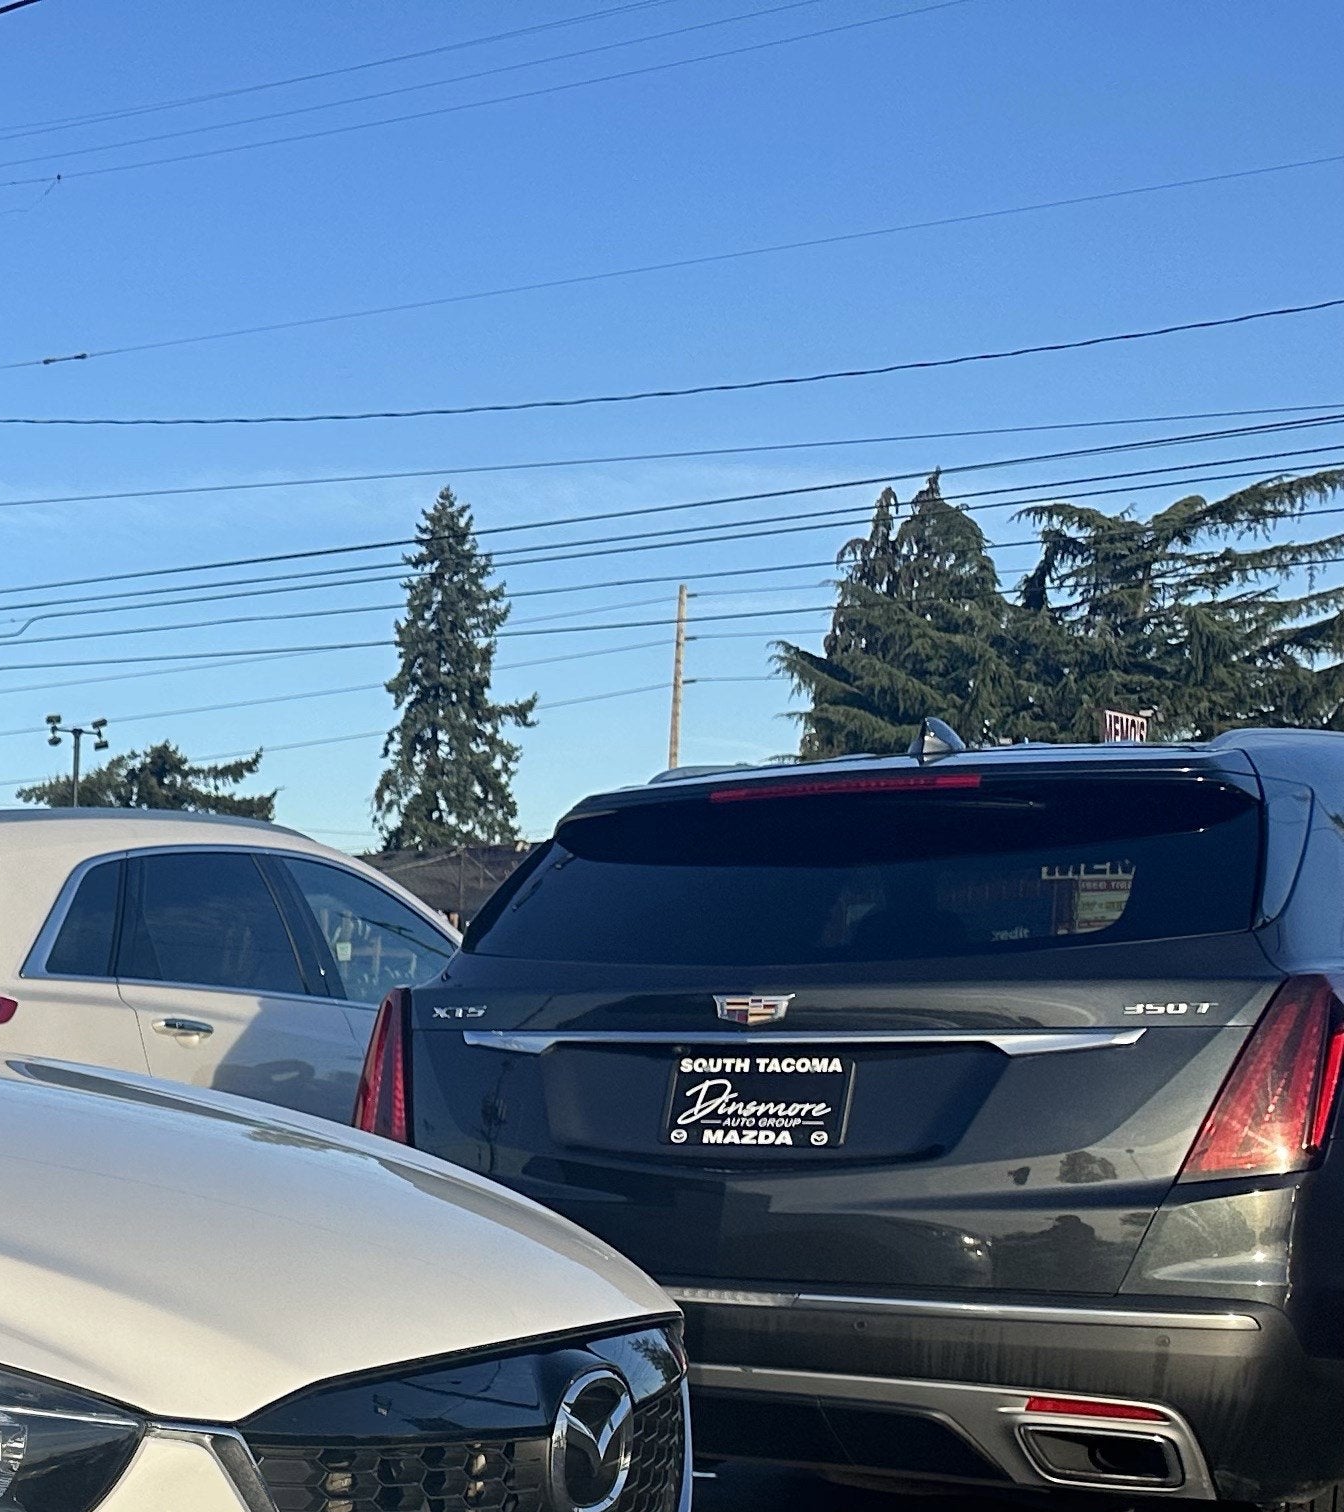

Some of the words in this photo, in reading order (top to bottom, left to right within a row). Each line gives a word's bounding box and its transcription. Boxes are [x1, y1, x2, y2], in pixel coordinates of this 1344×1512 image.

[680, 1057, 750, 1073] SOUTH
[756, 1057, 843, 1073] TACOMA
[677, 1078, 832, 1125] Dinsmore
[722, 1117, 756, 1127] AUTO
[758, 1117, 802, 1128] GROUP
[702, 1129, 793, 1145] MAZDA
